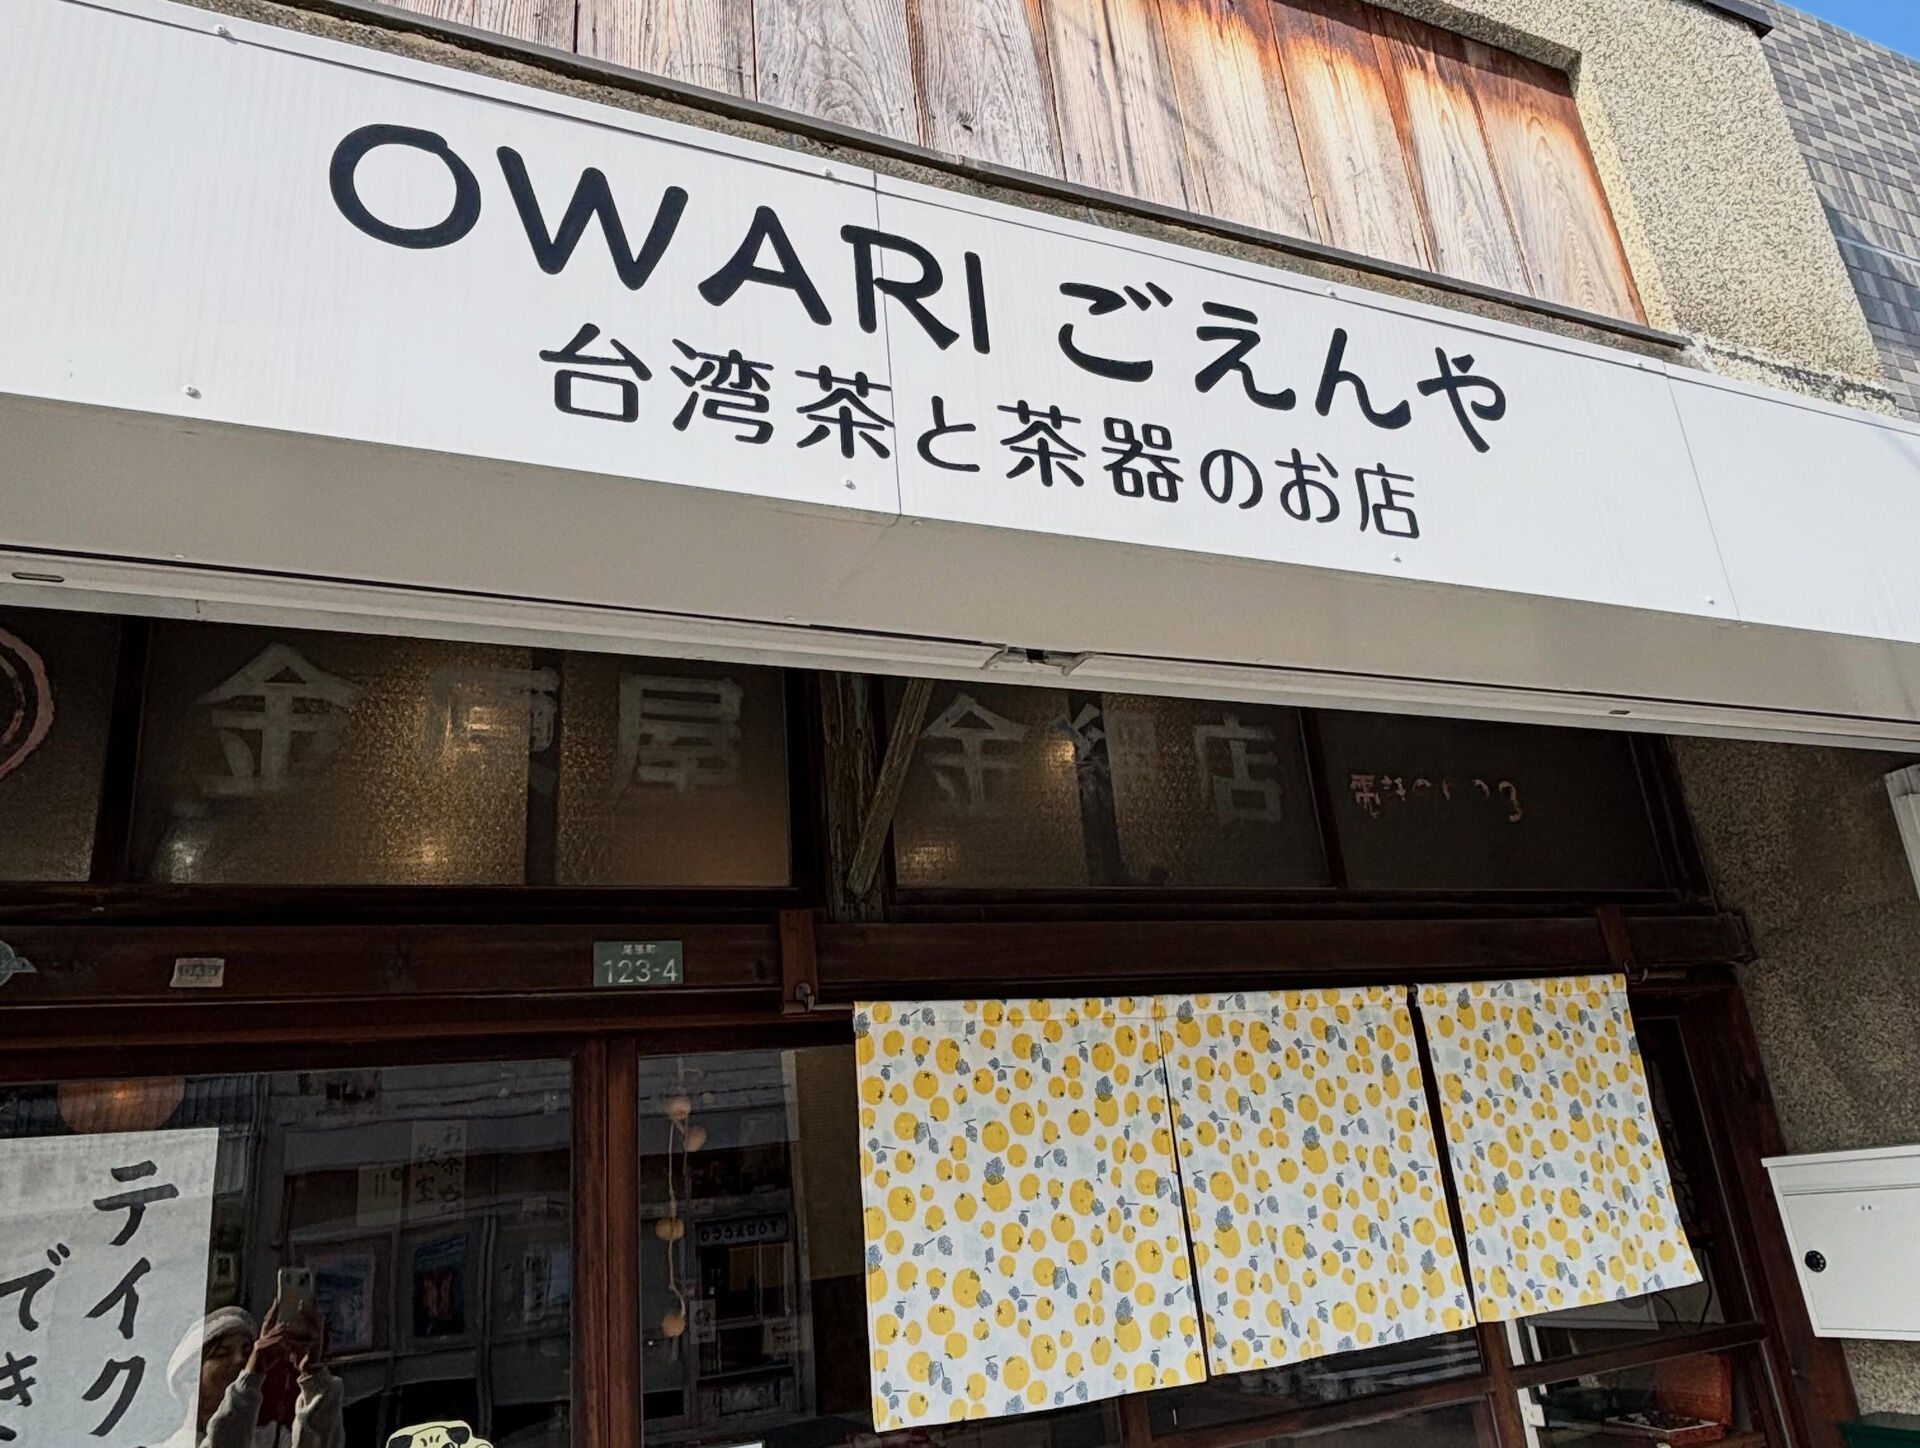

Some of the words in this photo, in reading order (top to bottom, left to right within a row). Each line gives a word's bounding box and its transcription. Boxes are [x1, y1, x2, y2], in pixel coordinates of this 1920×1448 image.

[329, 123, 990, 354] OWARI
[1058, 281, 1506, 453] ごえんや
[539, 323, 1420, 539] 台湾茶と茶器のお店
[604, 959, 678, 983] 123-4
[82, 1160, 179, 1448] テイク
